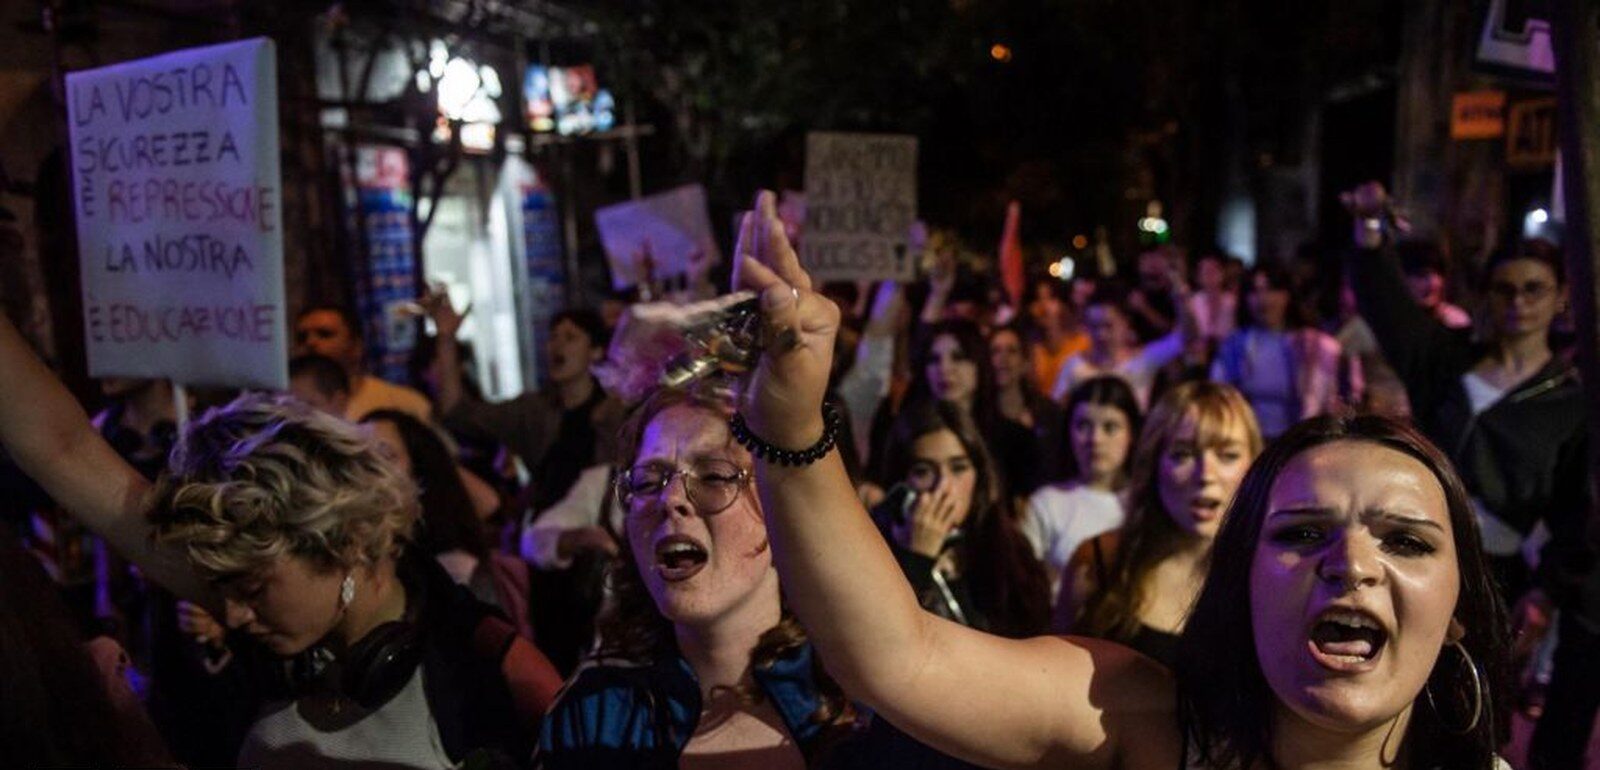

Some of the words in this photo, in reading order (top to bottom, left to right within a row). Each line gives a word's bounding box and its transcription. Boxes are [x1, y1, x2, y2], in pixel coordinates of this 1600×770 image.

[74, 83, 106, 126] LA
[115, 62, 247, 122] VOSTRA
[78, 129, 239, 173] SICUREZZA
[82, 175, 96, 216] È
[107, 179, 275, 232] REPRESSIONE
[105, 244, 138, 273] LA
[143, 234, 254, 279] NOSTRA
[89, 292, 105, 342] È
[110, 303, 276, 343] EDUCAZIONE
